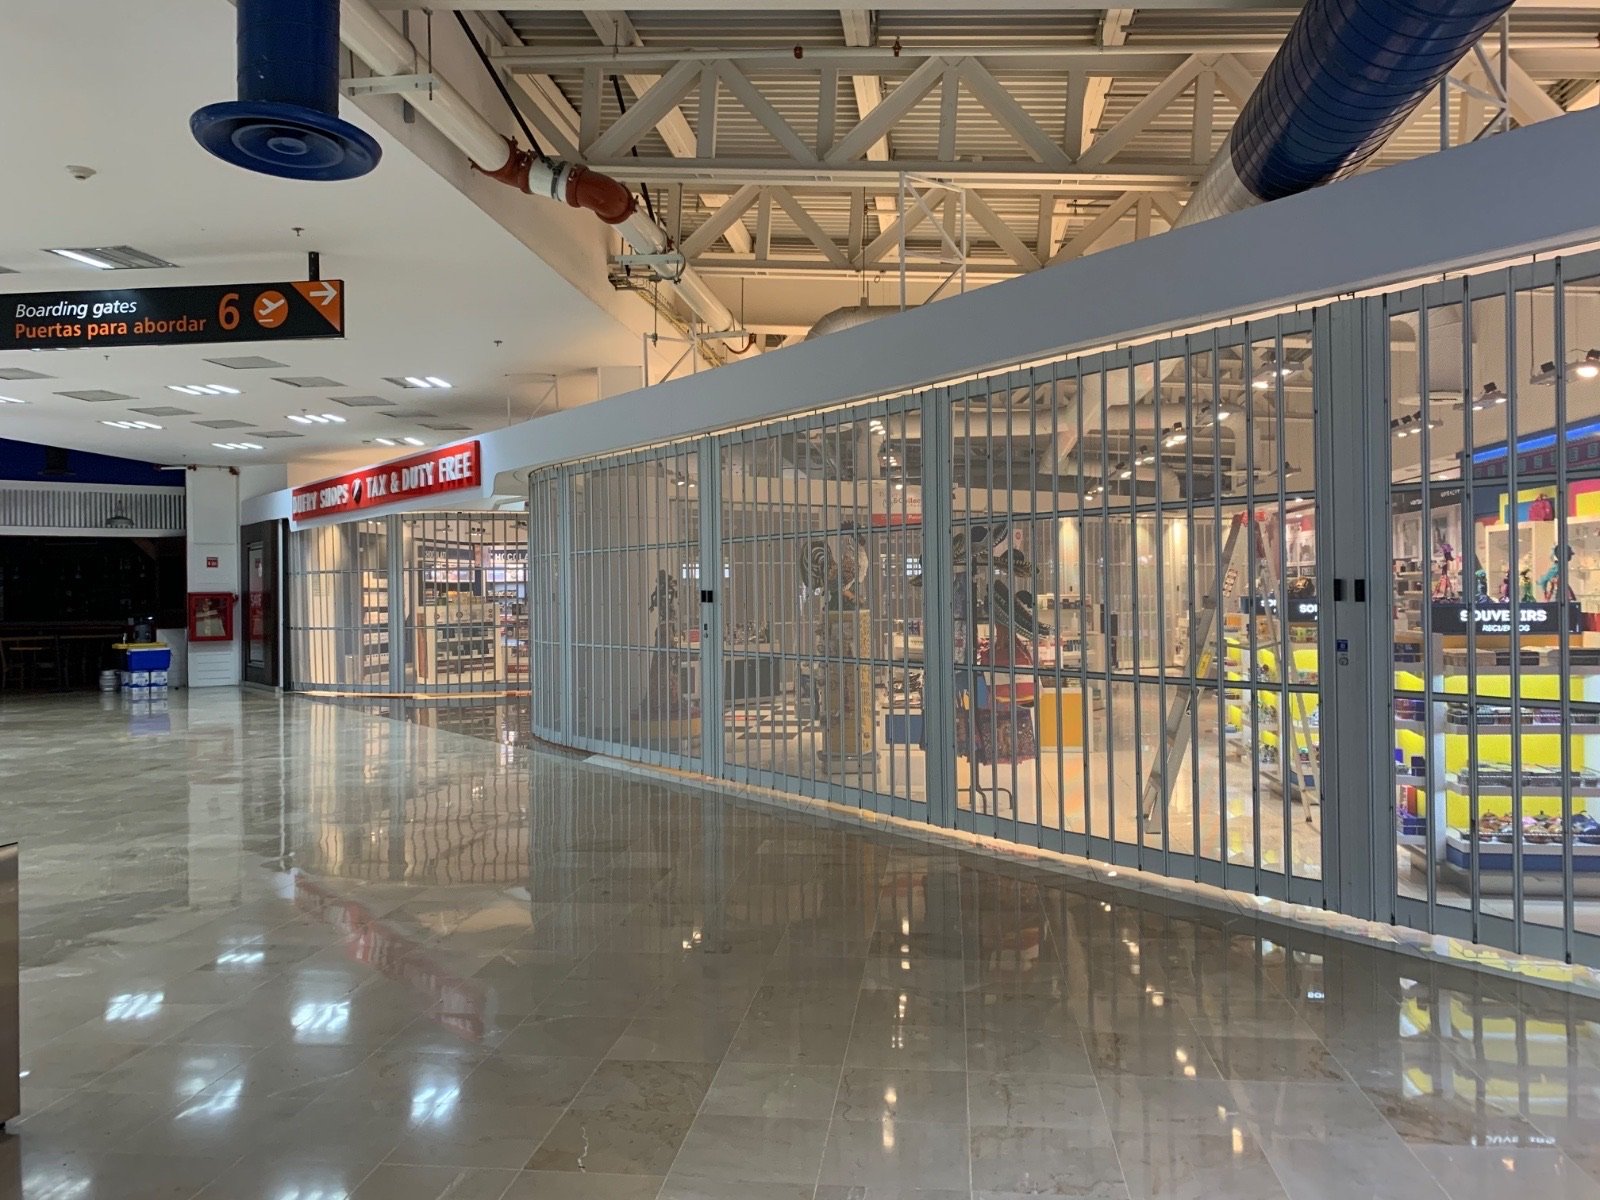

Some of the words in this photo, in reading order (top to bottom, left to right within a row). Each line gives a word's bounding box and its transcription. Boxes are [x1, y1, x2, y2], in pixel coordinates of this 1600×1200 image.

[15, 301, 88, 319] Boarding
[92, 300, 138, 316] gates
[218, 292, 241, 331] 6
[15, 322, 82, 339] Puertas
[87, 319, 128, 340] para
[133, 315, 207, 334] abordar
[366, 473, 387, 499] TAX
[390, 471, 400, 494] &
[402, 461, 435, 491] DUTY
[438, 451, 472, 483] FREE
[319, 483, 349, 508] SHOPS
